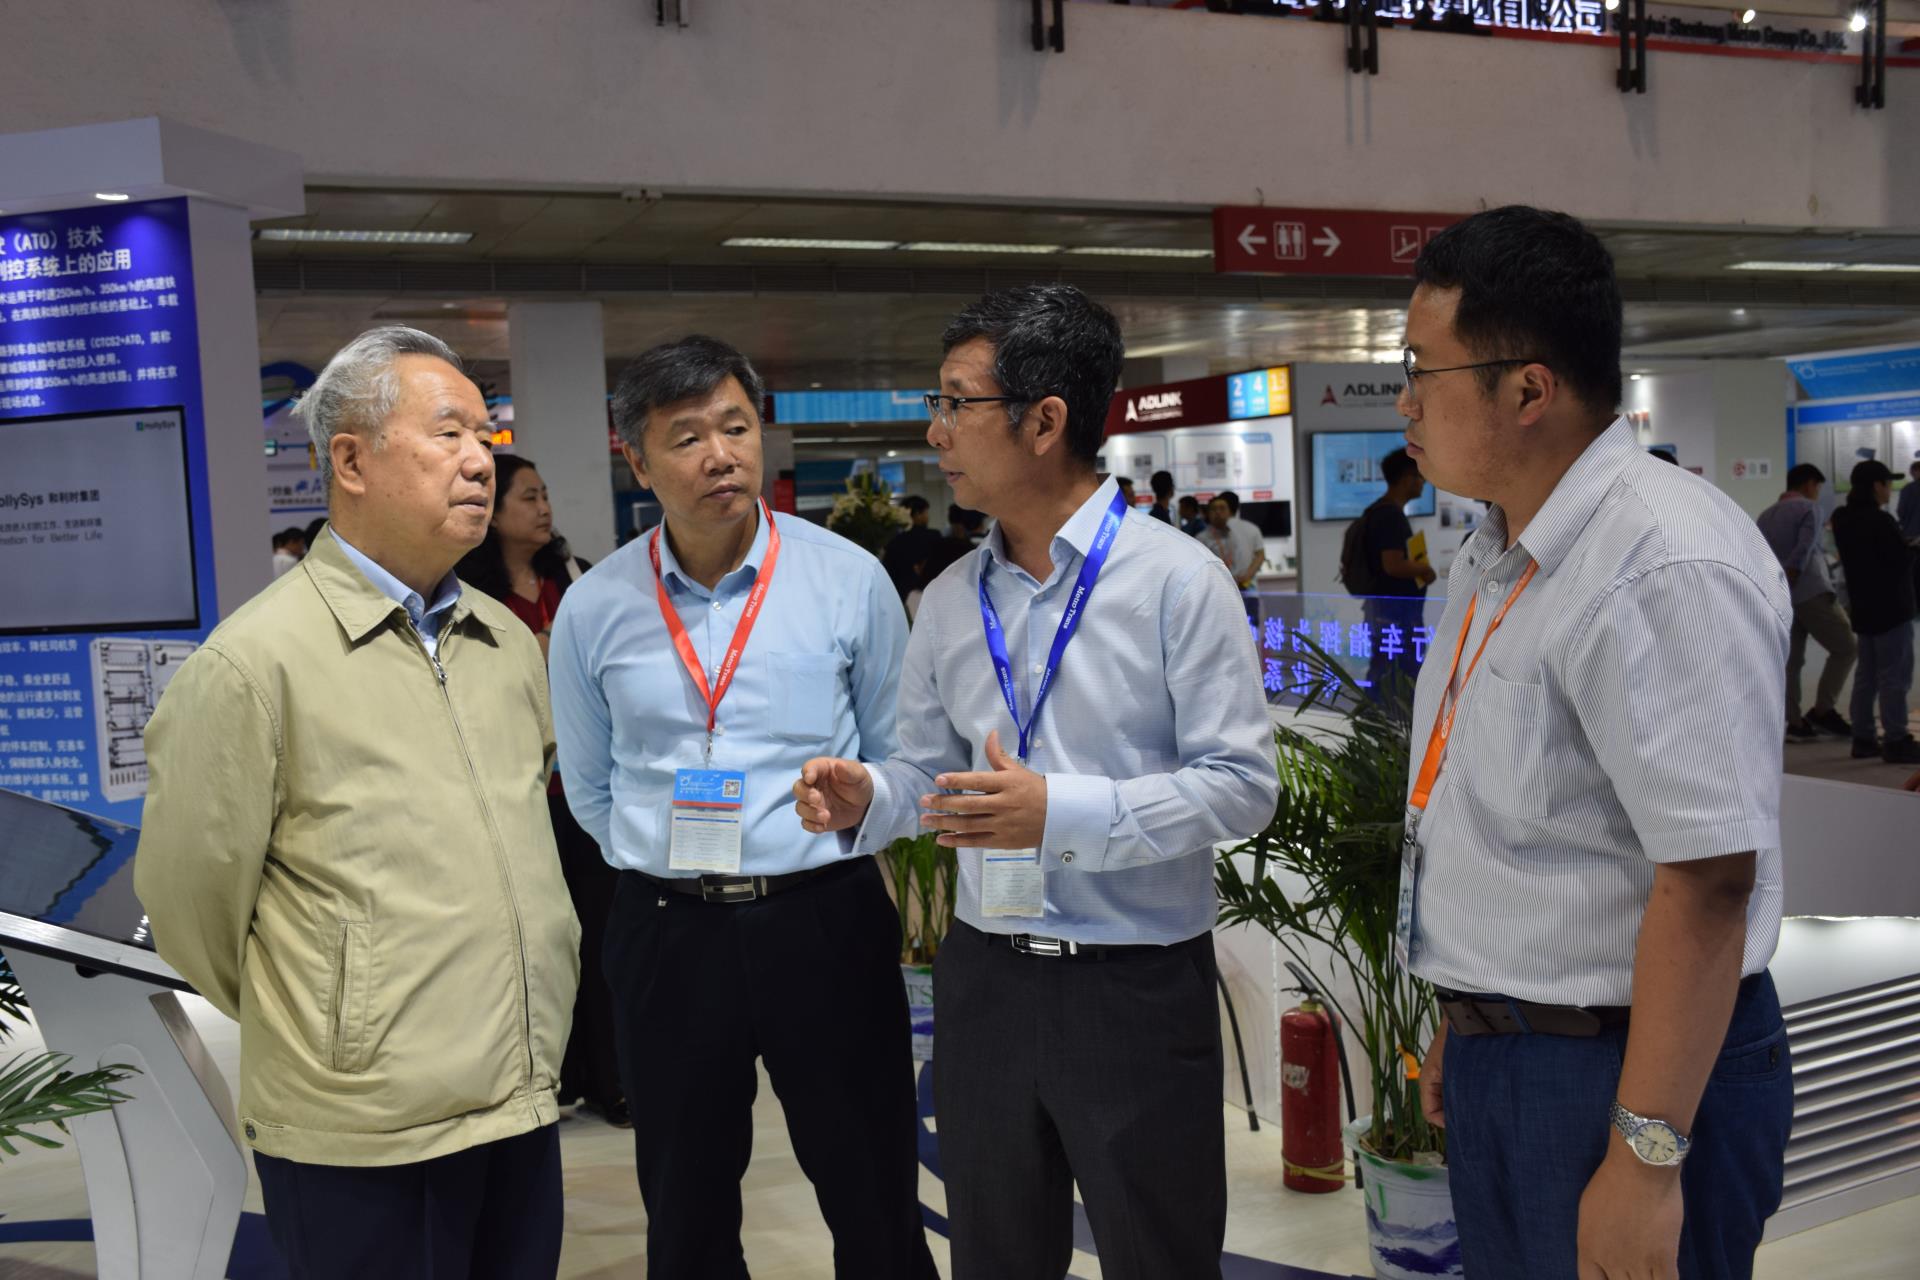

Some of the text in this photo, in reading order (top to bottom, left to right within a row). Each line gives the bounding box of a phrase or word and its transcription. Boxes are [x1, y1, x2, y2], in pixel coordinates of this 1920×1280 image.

[1343, 383, 1404, 397] ADLIN
[1138, 391, 1182, 411] ADLINK
[1063, 585, 1086, 629] Metro Trans
